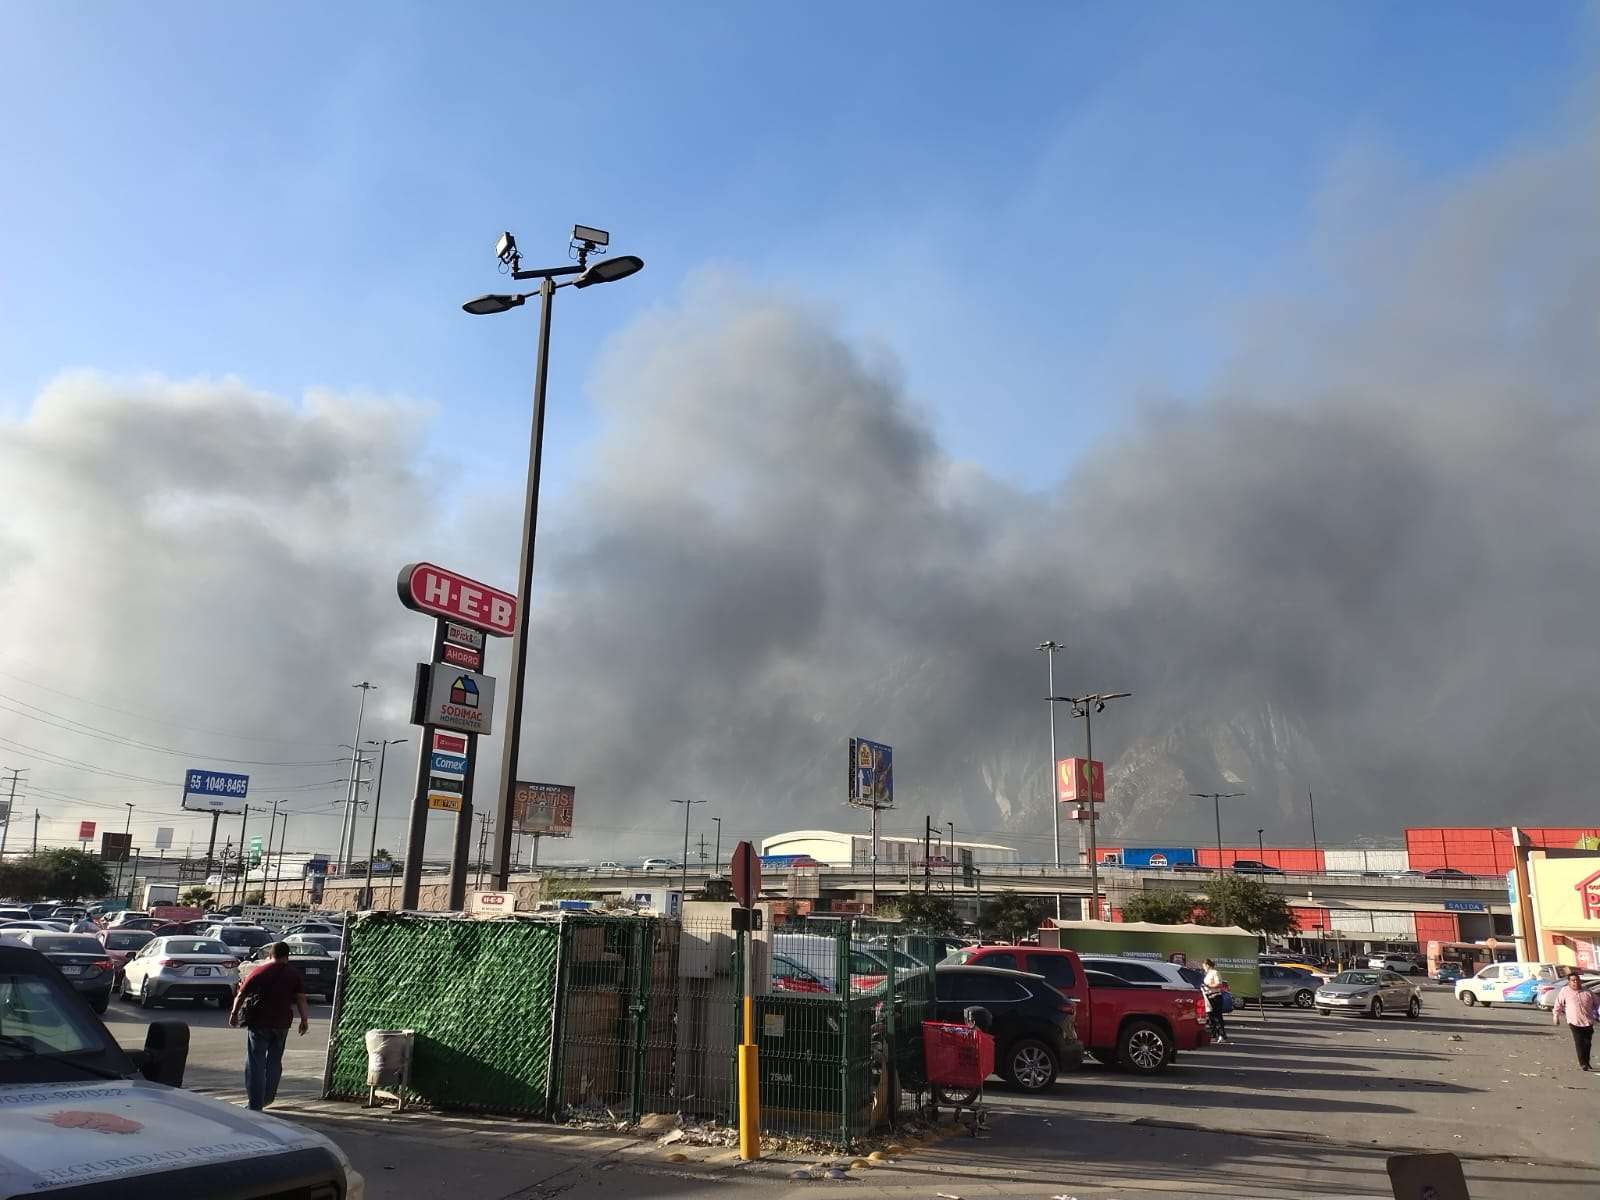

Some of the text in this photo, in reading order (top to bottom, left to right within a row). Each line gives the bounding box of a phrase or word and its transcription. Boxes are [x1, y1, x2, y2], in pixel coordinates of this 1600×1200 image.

[441, 704, 482, 721] SODIMAC
[435, 757, 465, 770] Comex
[191, 775, 202, 789] 55
[517, 790, 569, 806] GRATIS
[40, 1149, 187, 1181] SEGURIDAD
